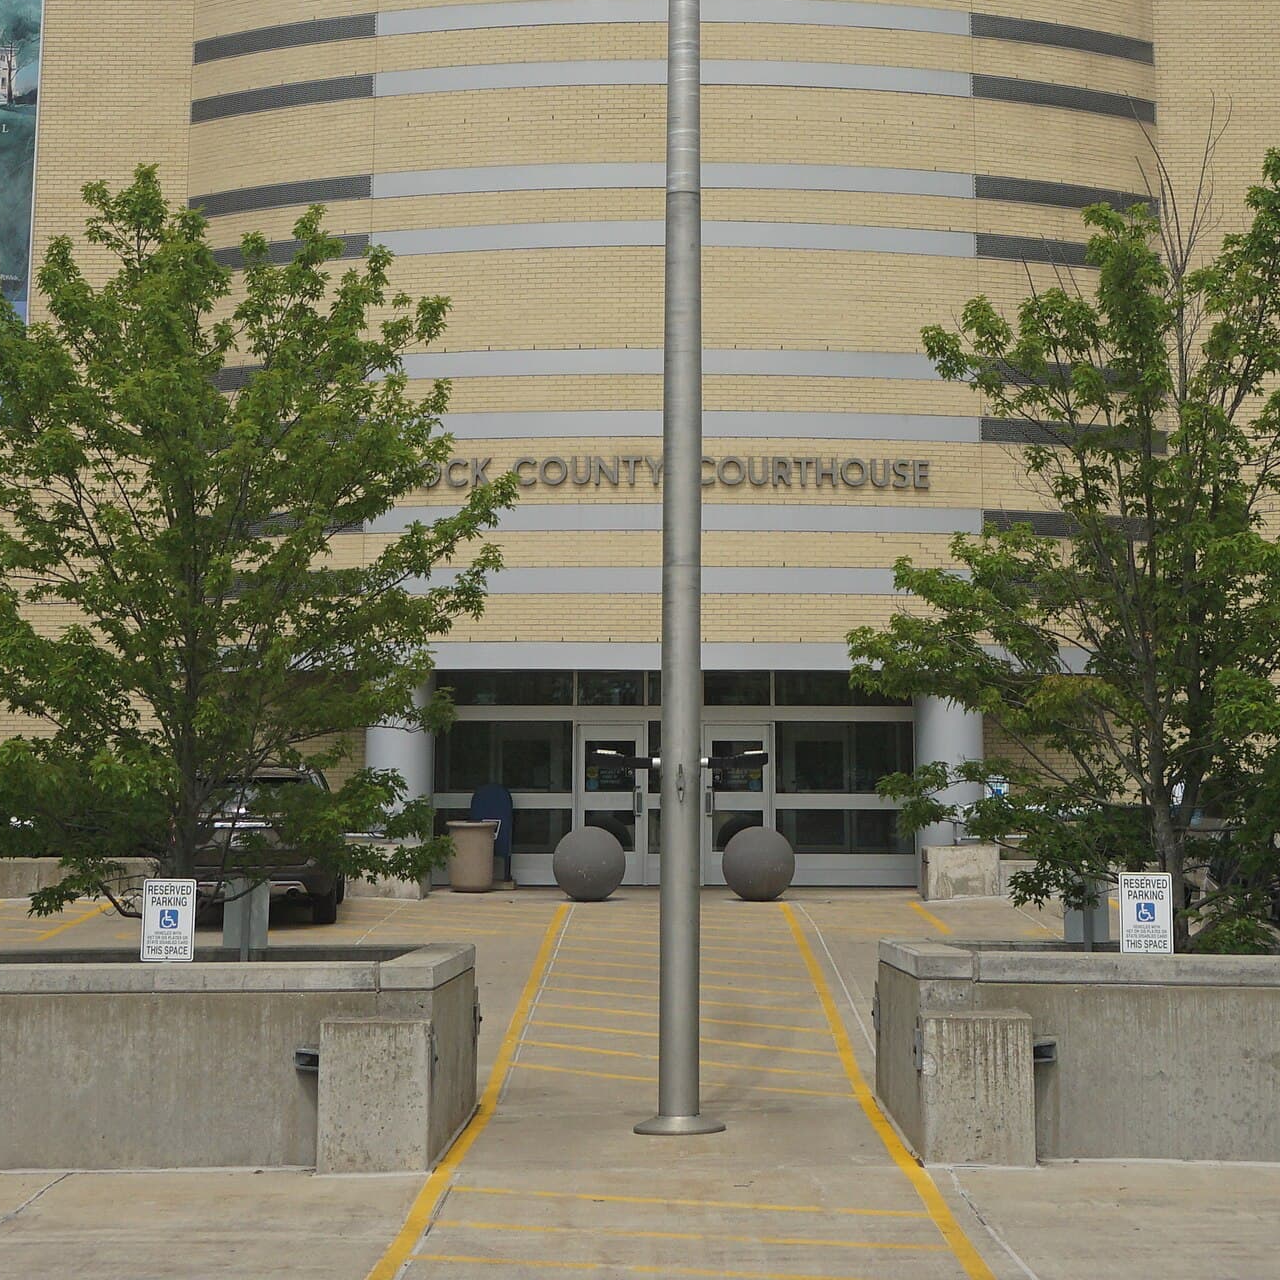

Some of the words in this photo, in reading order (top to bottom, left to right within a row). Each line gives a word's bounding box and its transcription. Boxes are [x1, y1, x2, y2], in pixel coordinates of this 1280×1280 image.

[418, 457, 492, 488] OCK
[513, 456, 664, 487] COUNTY
[701, 456, 930, 489] COURTHOUSE
[1123, 879, 1168, 889] RESERVED
[148, 885, 192, 895] RESERVED
[1127, 890, 1164, 900] PARKING
[151, 897, 188, 907] PARKING
[1126, 939, 1143, 949] THIS
[1143, 939, 1168, 949] SPACE
[147, 946, 163, 955] THIS
[164, 946, 188, 955] SPACE
